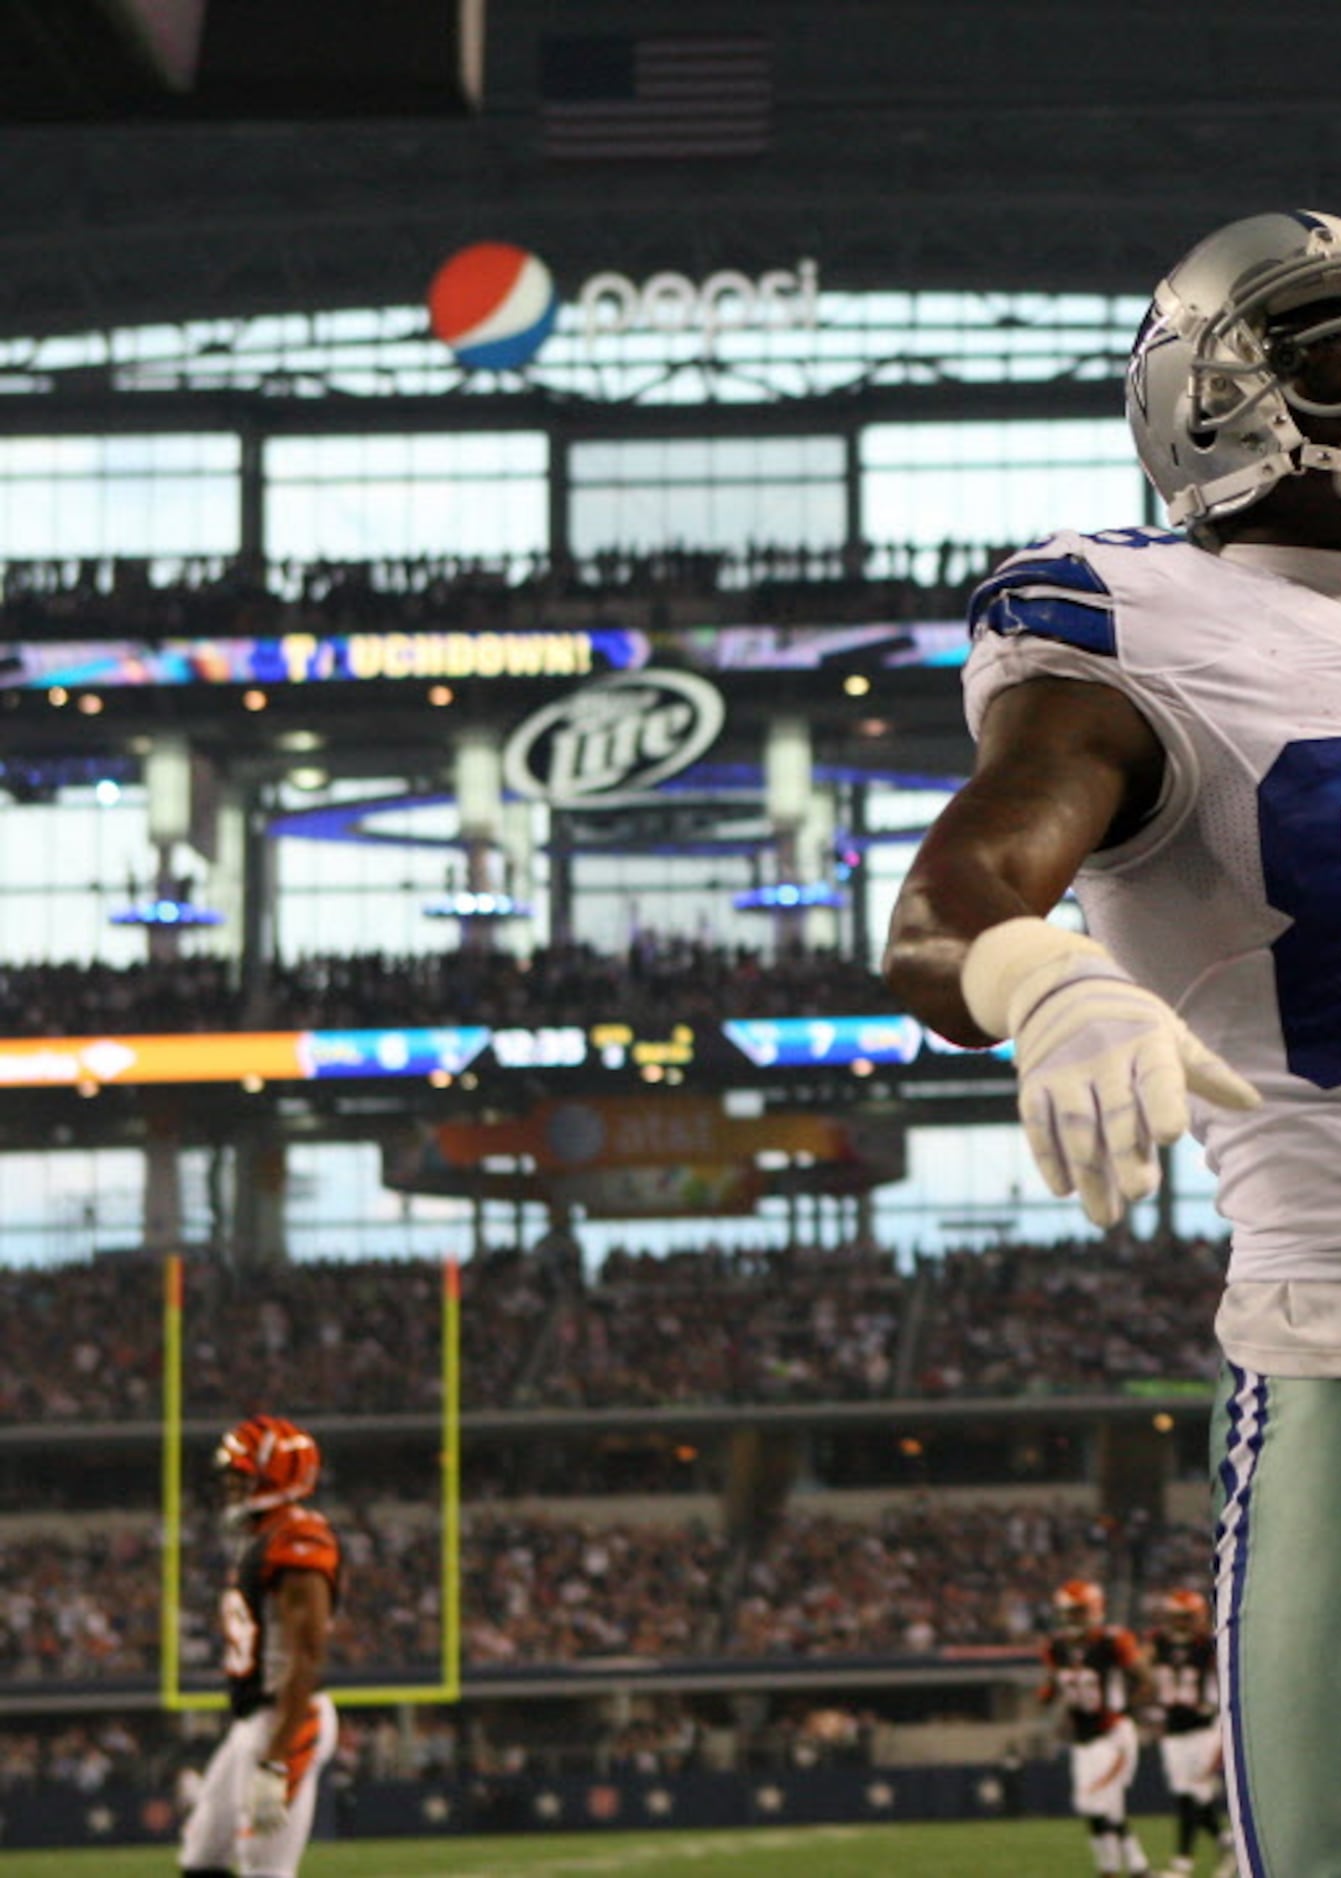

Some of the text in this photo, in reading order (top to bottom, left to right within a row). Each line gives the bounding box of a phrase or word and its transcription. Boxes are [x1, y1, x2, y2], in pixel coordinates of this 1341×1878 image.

[578, 258, 818, 355] pepsi
[281, 631, 593, 683] TUCHDOWN!
[550, 704, 692, 797] Lite
